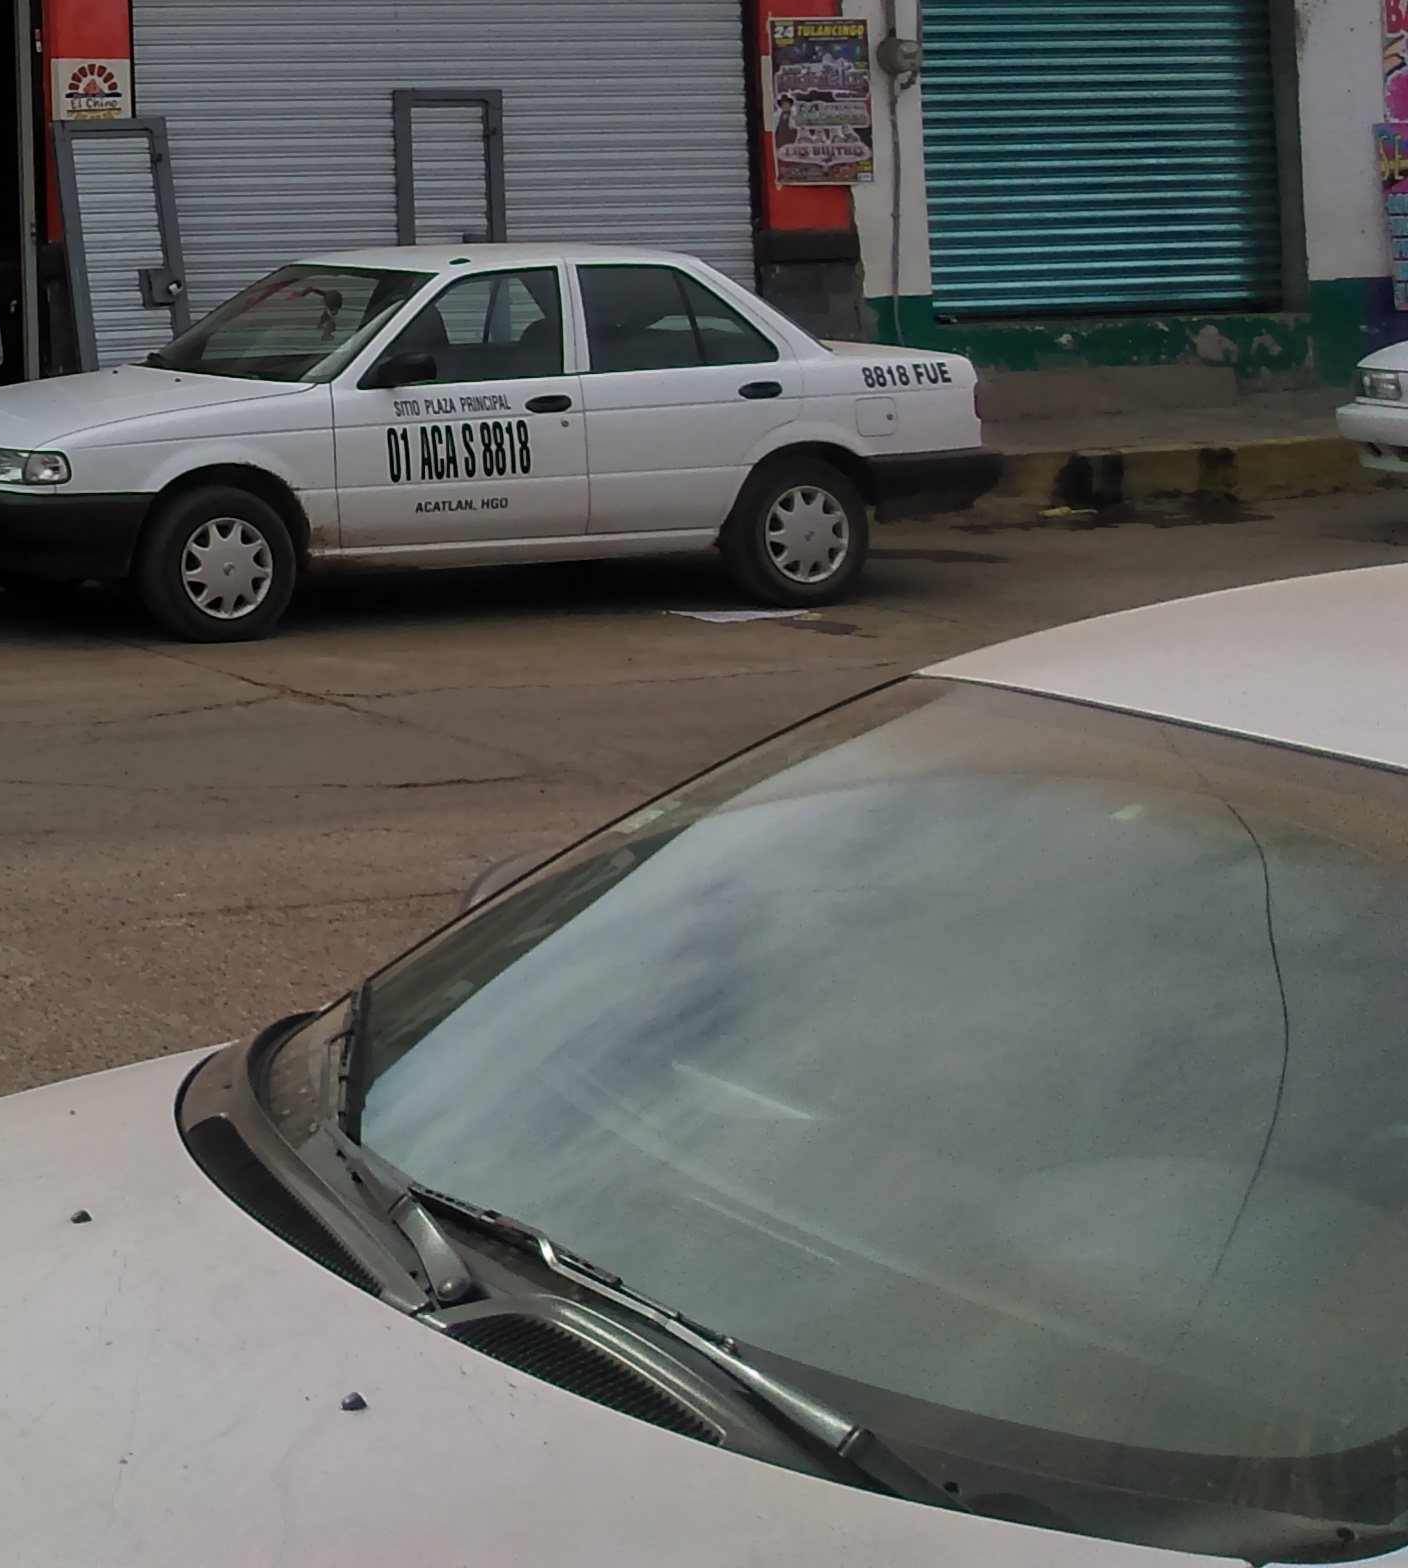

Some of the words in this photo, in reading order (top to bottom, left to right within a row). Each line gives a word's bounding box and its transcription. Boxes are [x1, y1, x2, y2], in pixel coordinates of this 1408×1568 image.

[796, 24, 865, 38] TULANCINGO
[70, 99, 83, 110] El
[862, 364, 910, 389] 8818
[912, 362, 952, 385] FUE
[394, 399, 420, 417] SITIO
[425, 397, 456, 415] PLAZA
[460, 394, 512, 413] PRINCIPAL
[387, 426, 412, 483] 01
[420, 424, 459, 481] ACA
[461, 422, 477, 478] S
[479, 419, 531, 477] 8818
[481, 497, 509, 509] HGO
